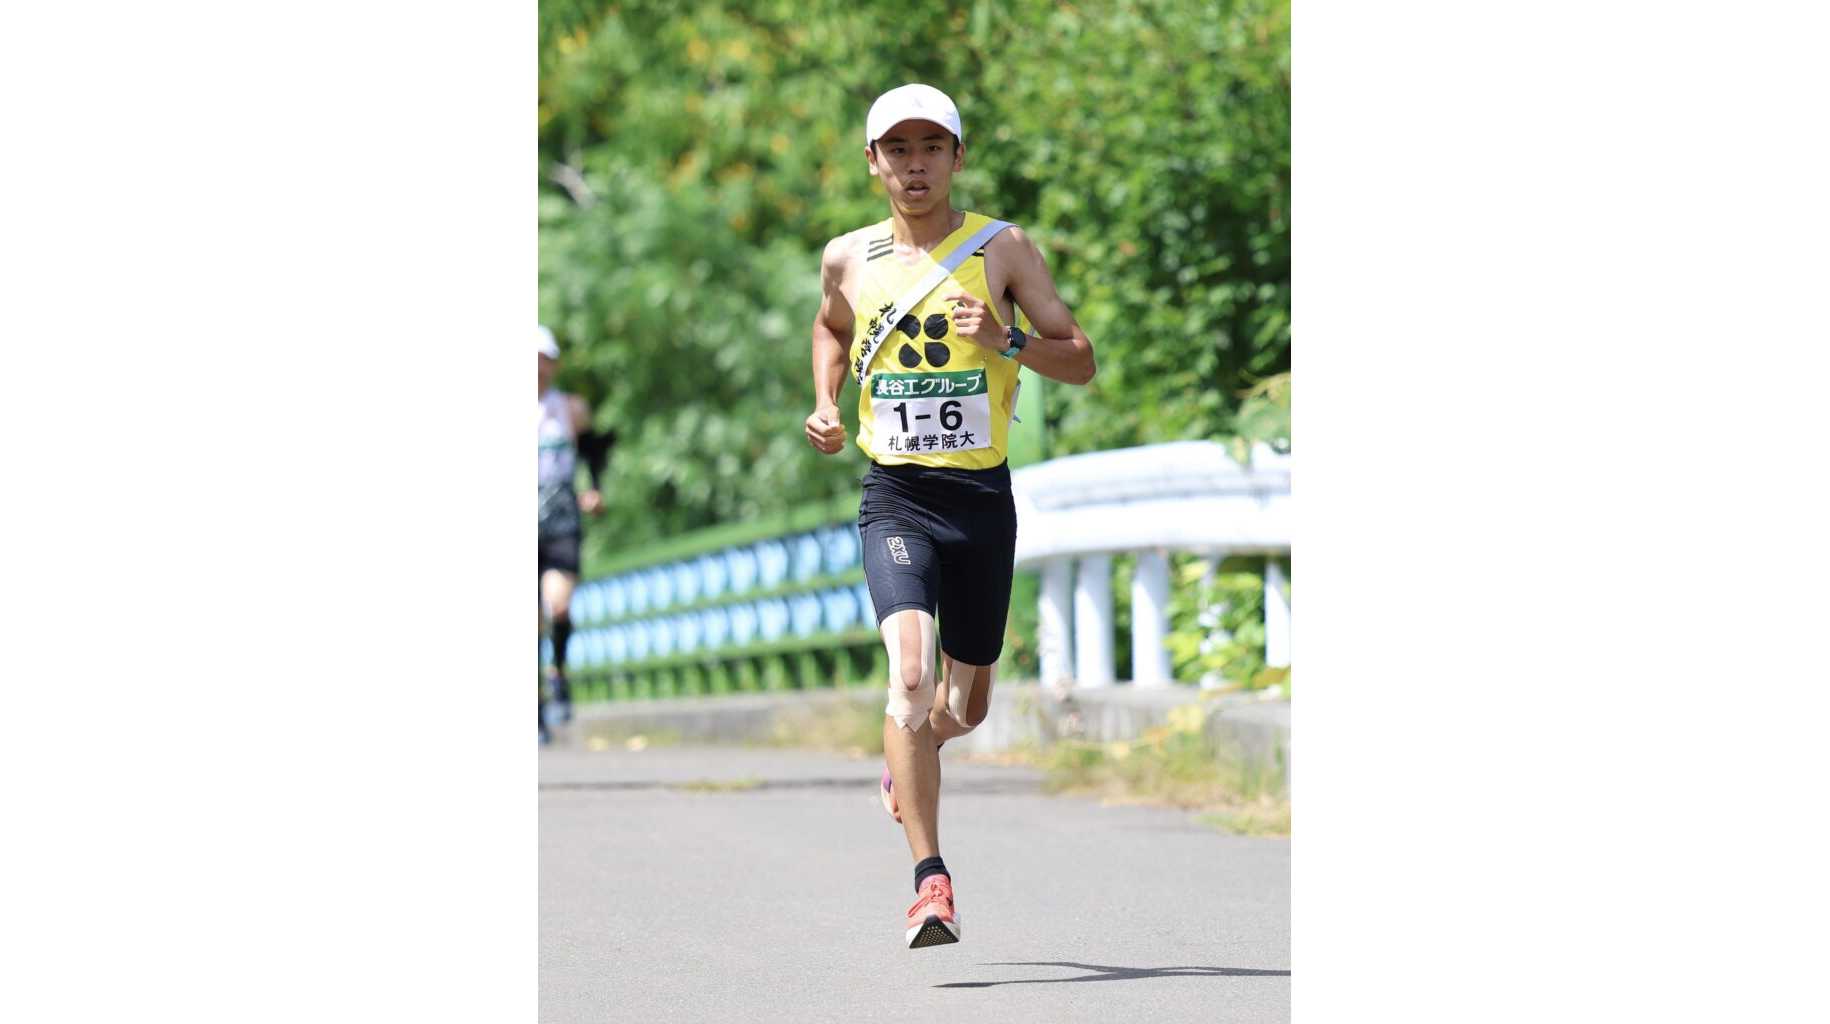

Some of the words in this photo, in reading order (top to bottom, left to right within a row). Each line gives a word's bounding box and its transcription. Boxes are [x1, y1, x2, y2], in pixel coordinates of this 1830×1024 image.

[876, 374, 982, 396] 長谷工グループ
[893, 400, 963, 433] 1-6
[888, 431, 975, 451] 札幌学院大
